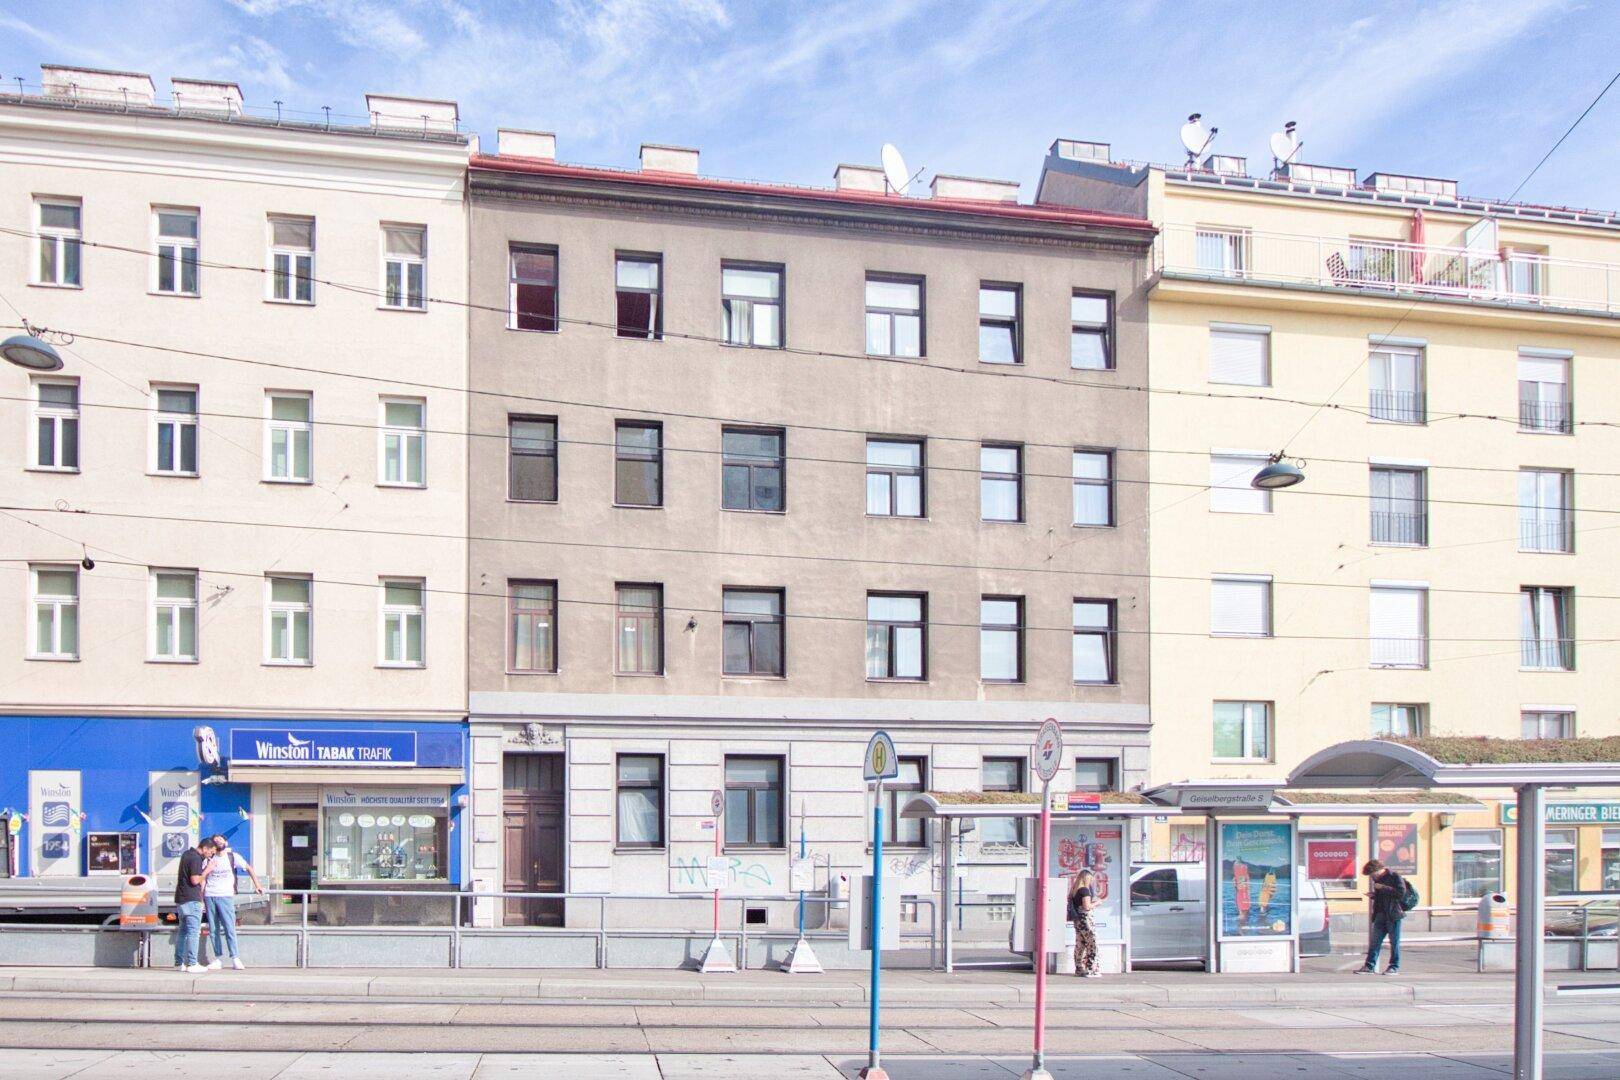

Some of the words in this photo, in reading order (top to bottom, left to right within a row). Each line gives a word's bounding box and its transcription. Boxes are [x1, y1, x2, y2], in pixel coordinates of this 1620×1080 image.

[256, 739, 310, 760] Winston
[317, 746, 355, 760] TABAK
[357, 747, 392, 760] TRAFIK
[875, 746, 883, 768] H
[40, 786, 72, 798] Winston
[160, 787, 191, 798] Winston
[326, 793, 356, 804] Winston
[360, 795, 388, 804] HÖCHSTE
[389, 795, 416, 804] QUALITÄT
[416, 796, 429, 804] SEIT
[1545, 806, 1596, 820] MERINGER
[43, 840, 70, 852] 1954
